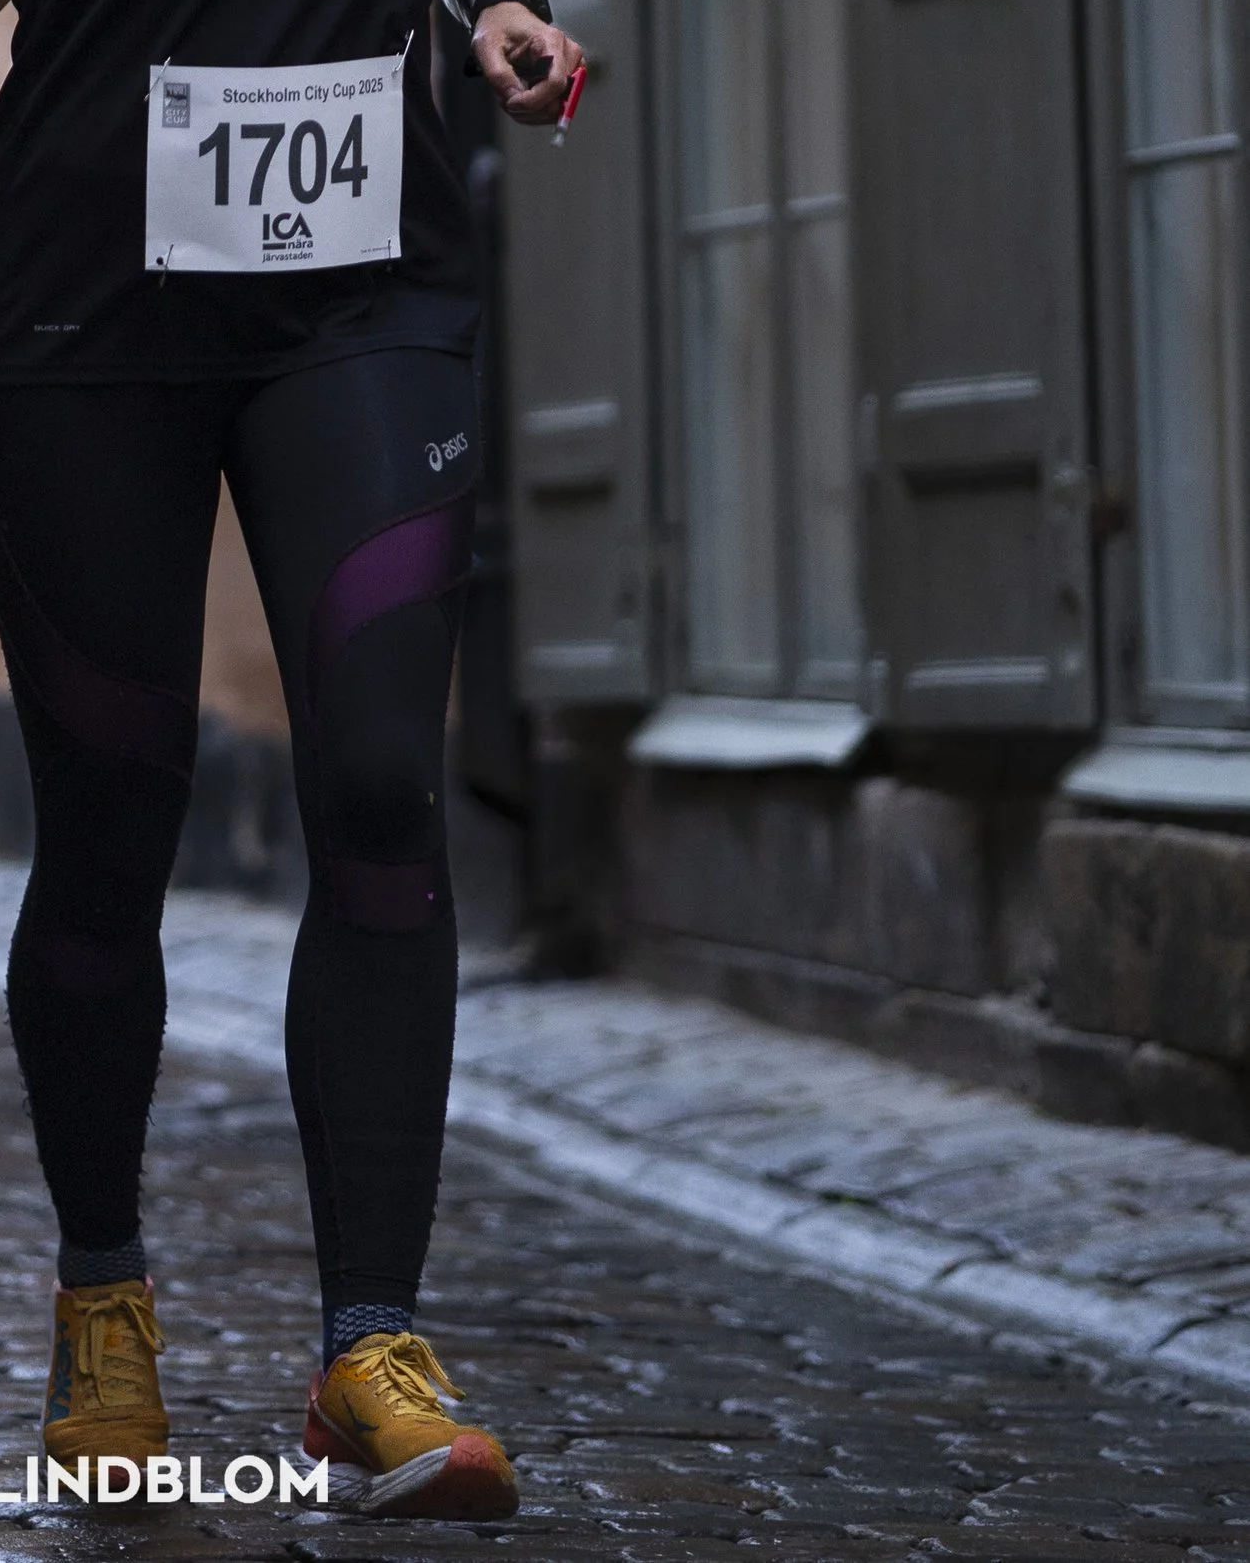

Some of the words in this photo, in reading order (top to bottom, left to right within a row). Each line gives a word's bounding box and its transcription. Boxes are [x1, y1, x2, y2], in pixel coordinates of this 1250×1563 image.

[223, 88, 300, 103] Stockholm
[304, 85, 329, 103] City
[333, 82, 355, 99] Cup
[358, 77, 384, 95] 2025
[198, 113, 368, 206] 1704
[262, 211, 313, 240] ICA
[288, 238, 314, 249] nära
